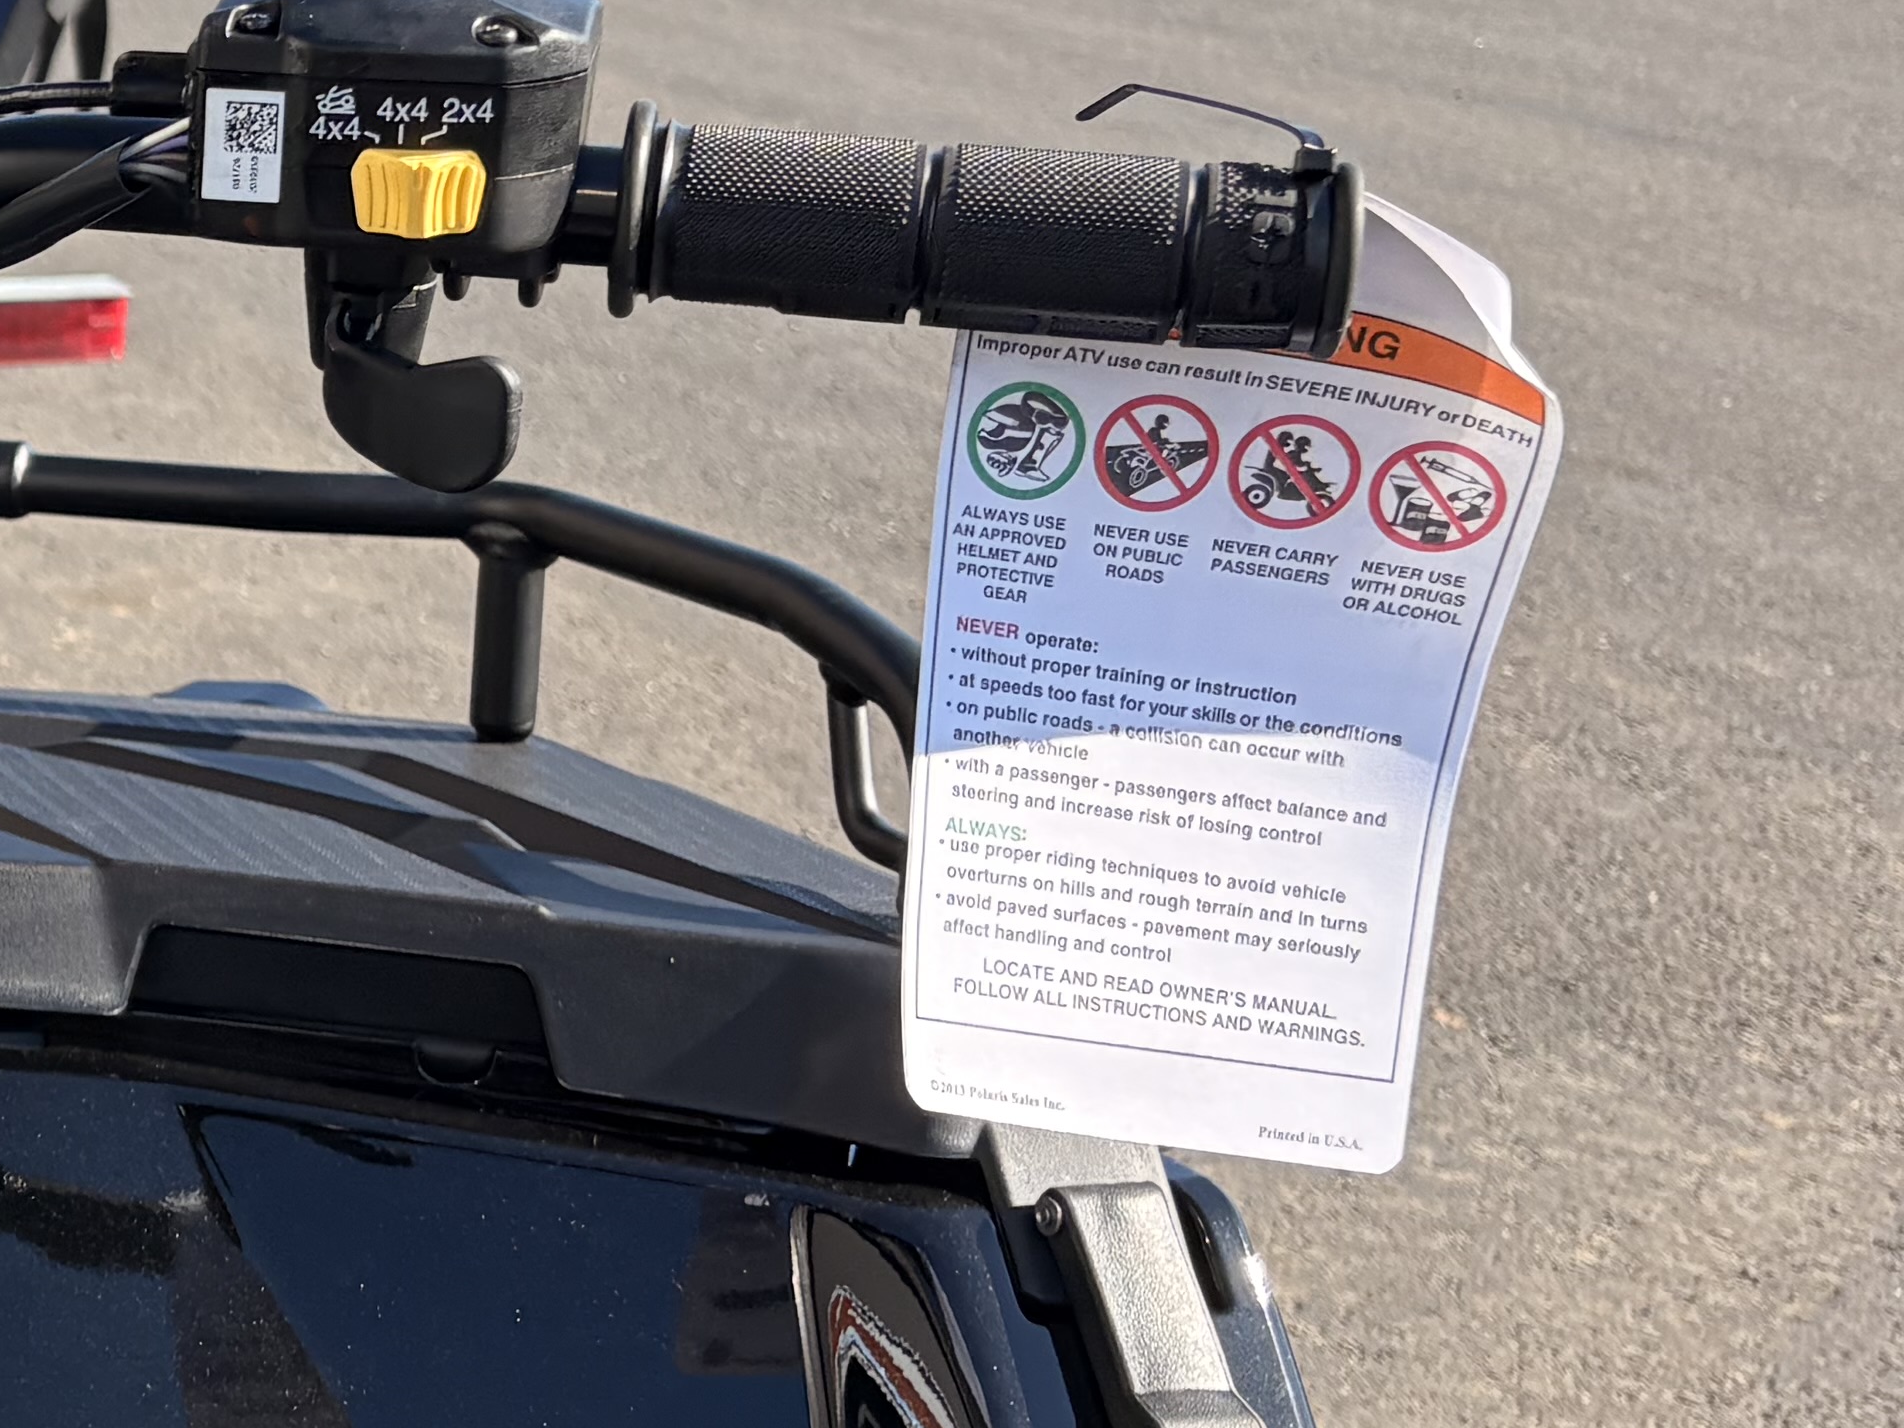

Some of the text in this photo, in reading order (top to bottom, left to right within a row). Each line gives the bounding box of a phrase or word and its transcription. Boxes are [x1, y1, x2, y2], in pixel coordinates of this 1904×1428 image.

[309, 97, 495, 141] 4x4 4x4 2x4
[961, 504, 1066, 531] ALWAYS USE
[952, 522, 1066, 550] AN APPROVED
[1093, 523, 1189, 547] NEVER USE
[957, 542, 1057, 568] HELMET AND
[1093, 542, 1183, 566] ON PUBLIC
[1211, 538, 1339, 567] NEVER CARRY
[956, 561, 1054, 587] PROTECTIVE
[1105, 563, 1164, 583] ROADS
[1210, 557, 1330, 585] PASSENGERS
[1360, 559, 1466, 588] NEVER USE
[983, 585, 1027, 603] GEAR
[1351, 577, 1466, 607] WITH DRUGS
[1342, 596, 1461, 626] OR ALCOHOL
[983, 957, 1336, 1019] LOCATE AND READ OWNER'S MANUAL.
[953, 977, 1364, 1047] FOLLOW ALL INSTRUCTIONS AND WARNINGS.
